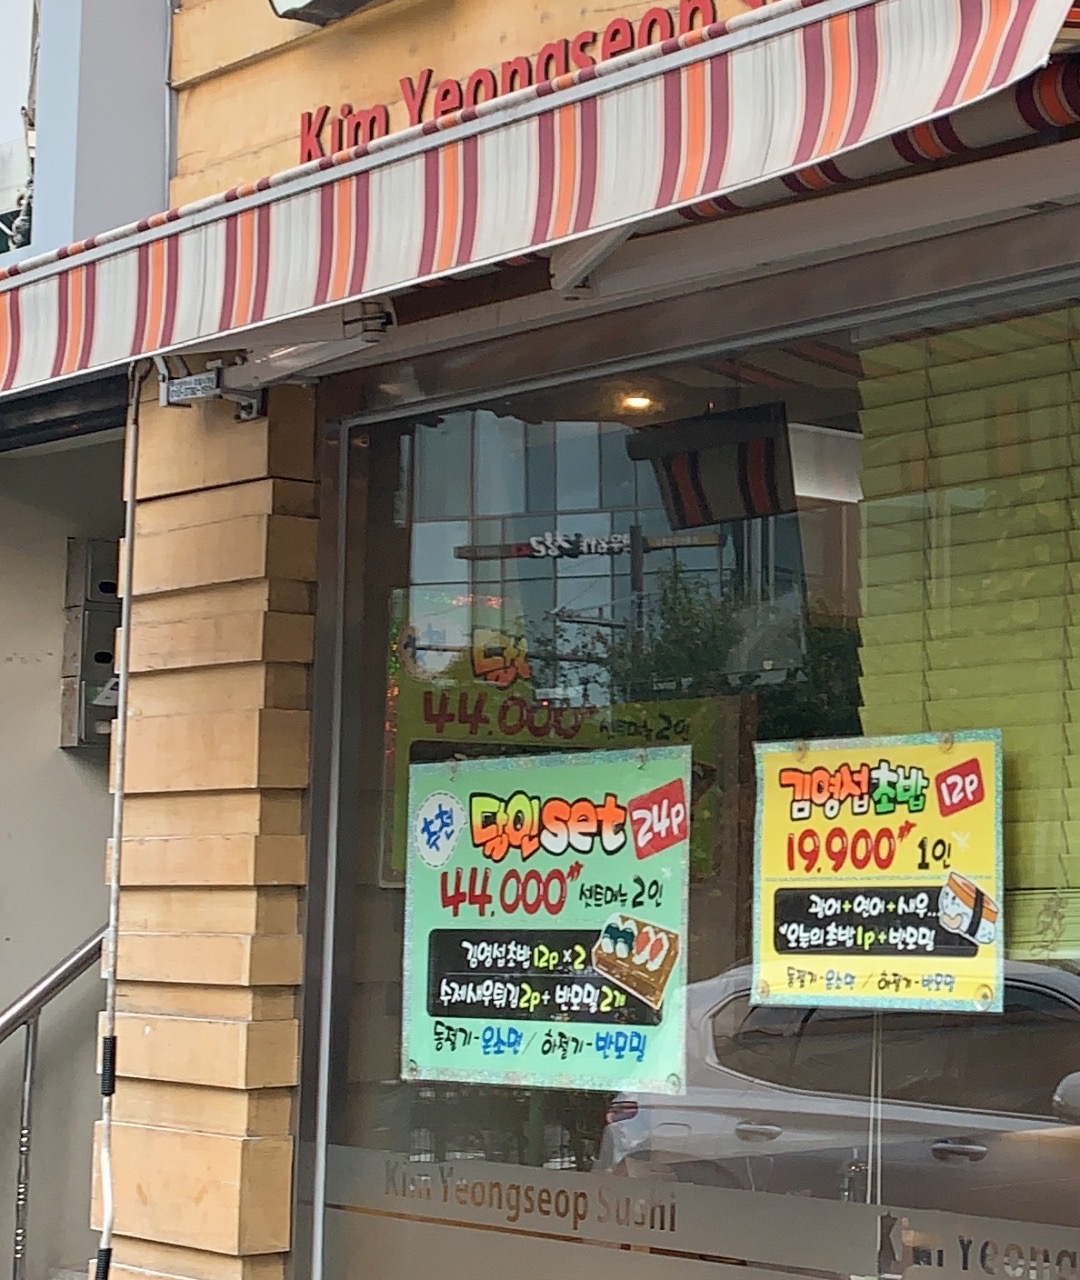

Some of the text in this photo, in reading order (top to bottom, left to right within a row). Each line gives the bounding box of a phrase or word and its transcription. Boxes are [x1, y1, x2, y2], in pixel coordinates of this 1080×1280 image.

[300, 103, 389, 164] Kim
[917, 836, 952, 870] 1인
[439, 1164, 589, 1230] Yeongseop
